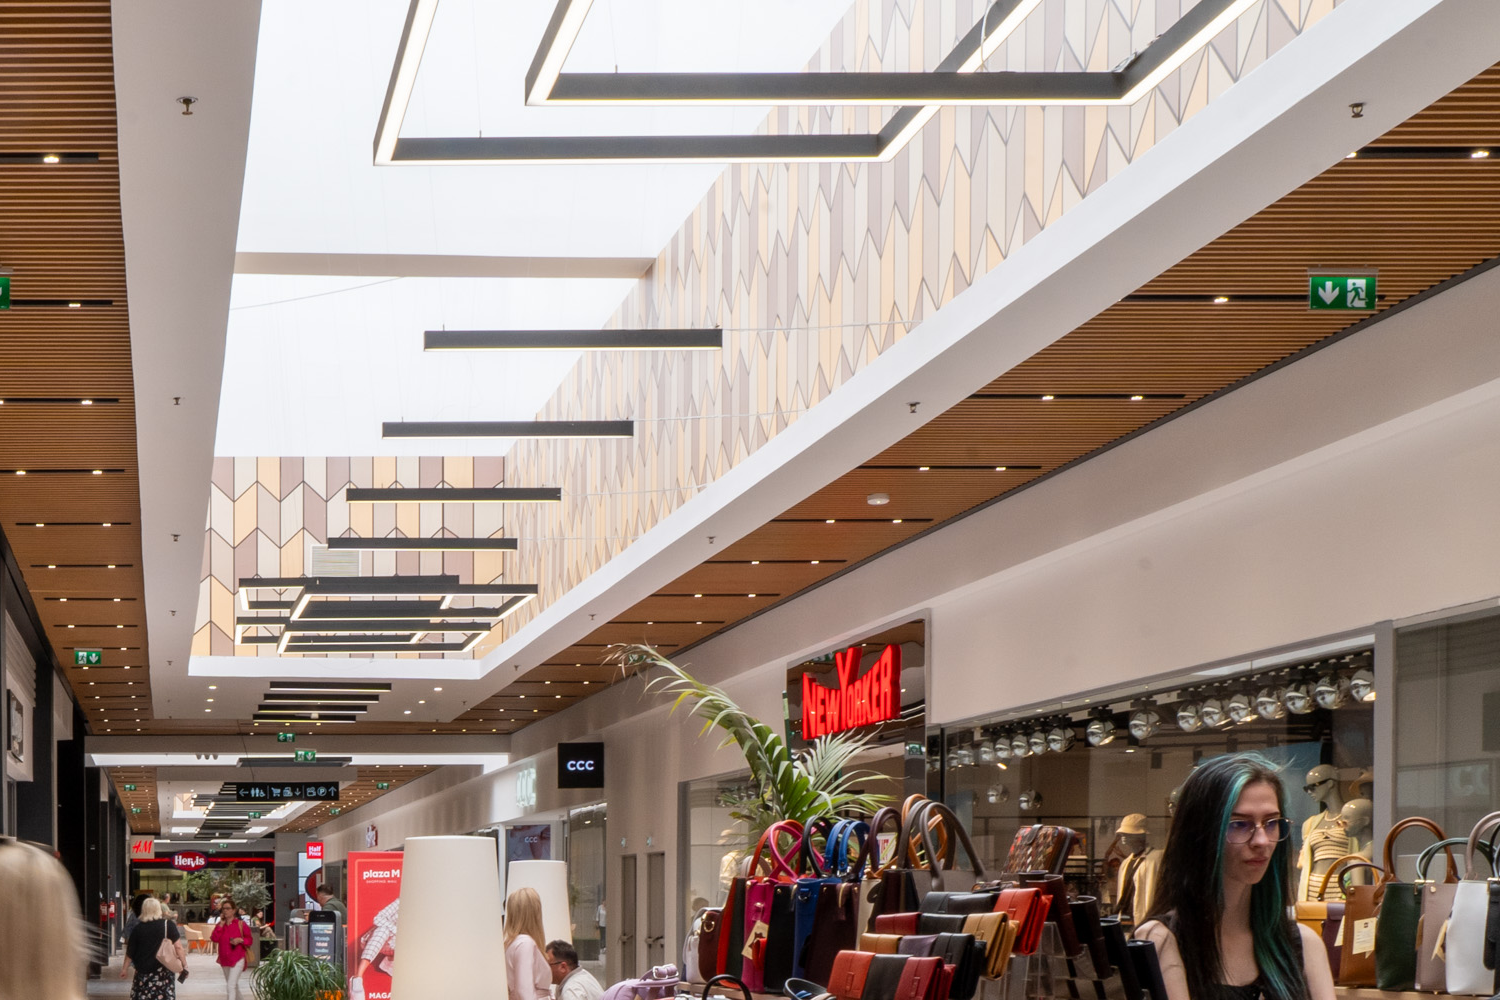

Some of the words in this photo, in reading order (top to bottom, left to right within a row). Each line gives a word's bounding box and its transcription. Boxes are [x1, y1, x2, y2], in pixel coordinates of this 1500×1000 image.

[835, 644, 894, 731] YORKER
[803, 672, 841, 740] NEW
[567, 760, 595, 771] CCC
[132, 840, 153, 854] H&M
[174, 853, 205, 867] Hervis
[363, 869, 390, 880] plaza
[391, 869, 400, 878] M
